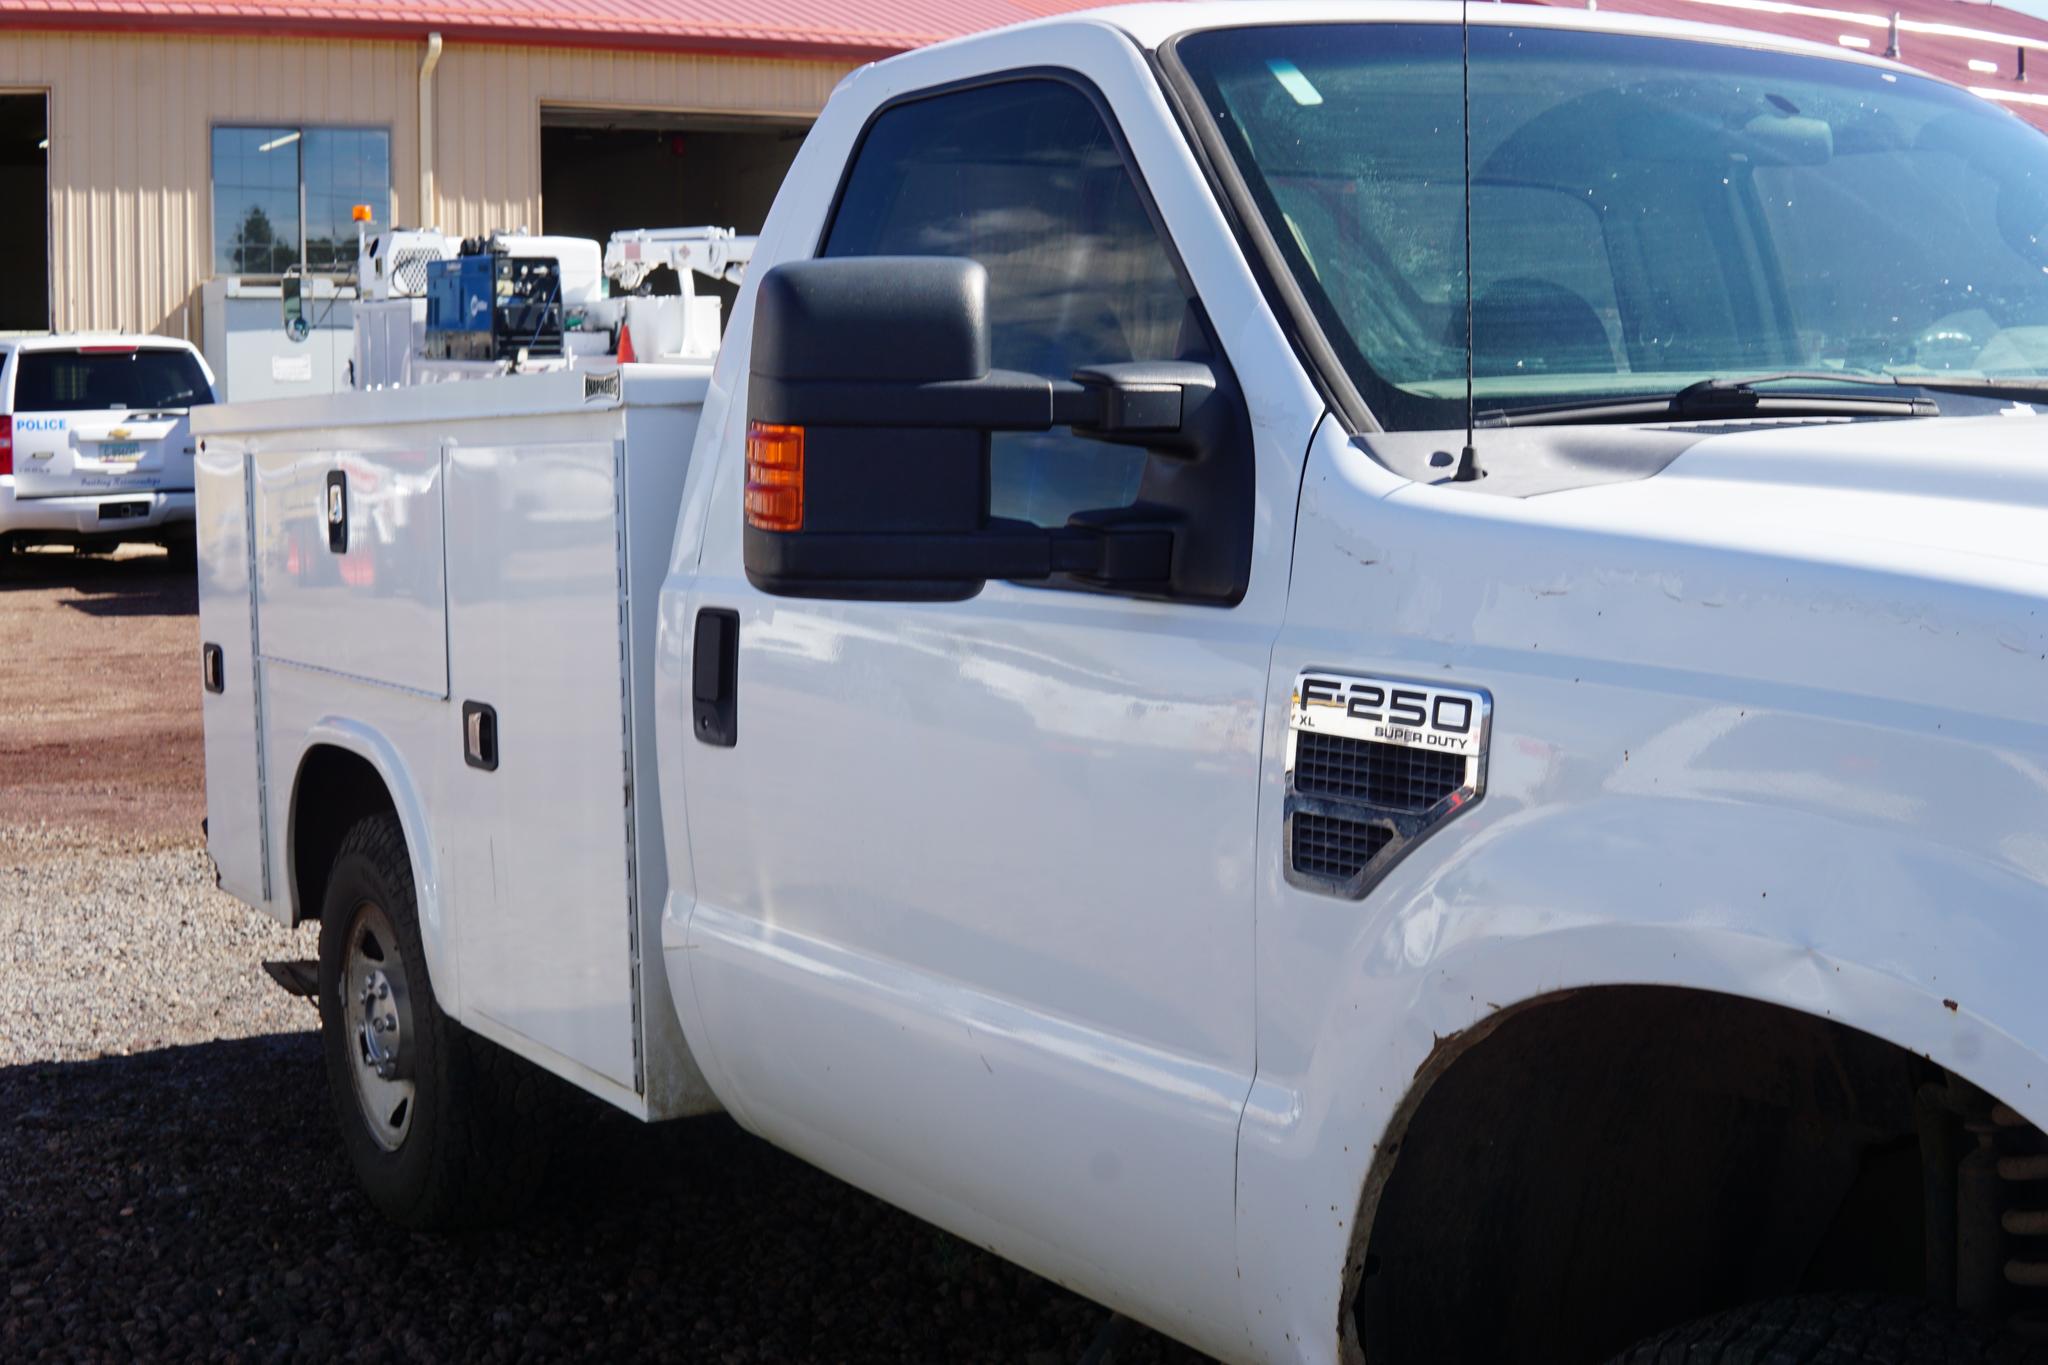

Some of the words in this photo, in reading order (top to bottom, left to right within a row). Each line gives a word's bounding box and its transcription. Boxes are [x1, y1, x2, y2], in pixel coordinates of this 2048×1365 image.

[16, 419, 66, 431] POLICE
[1301, 679, 1472, 733] F-250
[1299, 715, 1315, 727] XL
[1374, 726, 1422, 743] SUPER
[1427, 734, 1468, 749] DUTY
